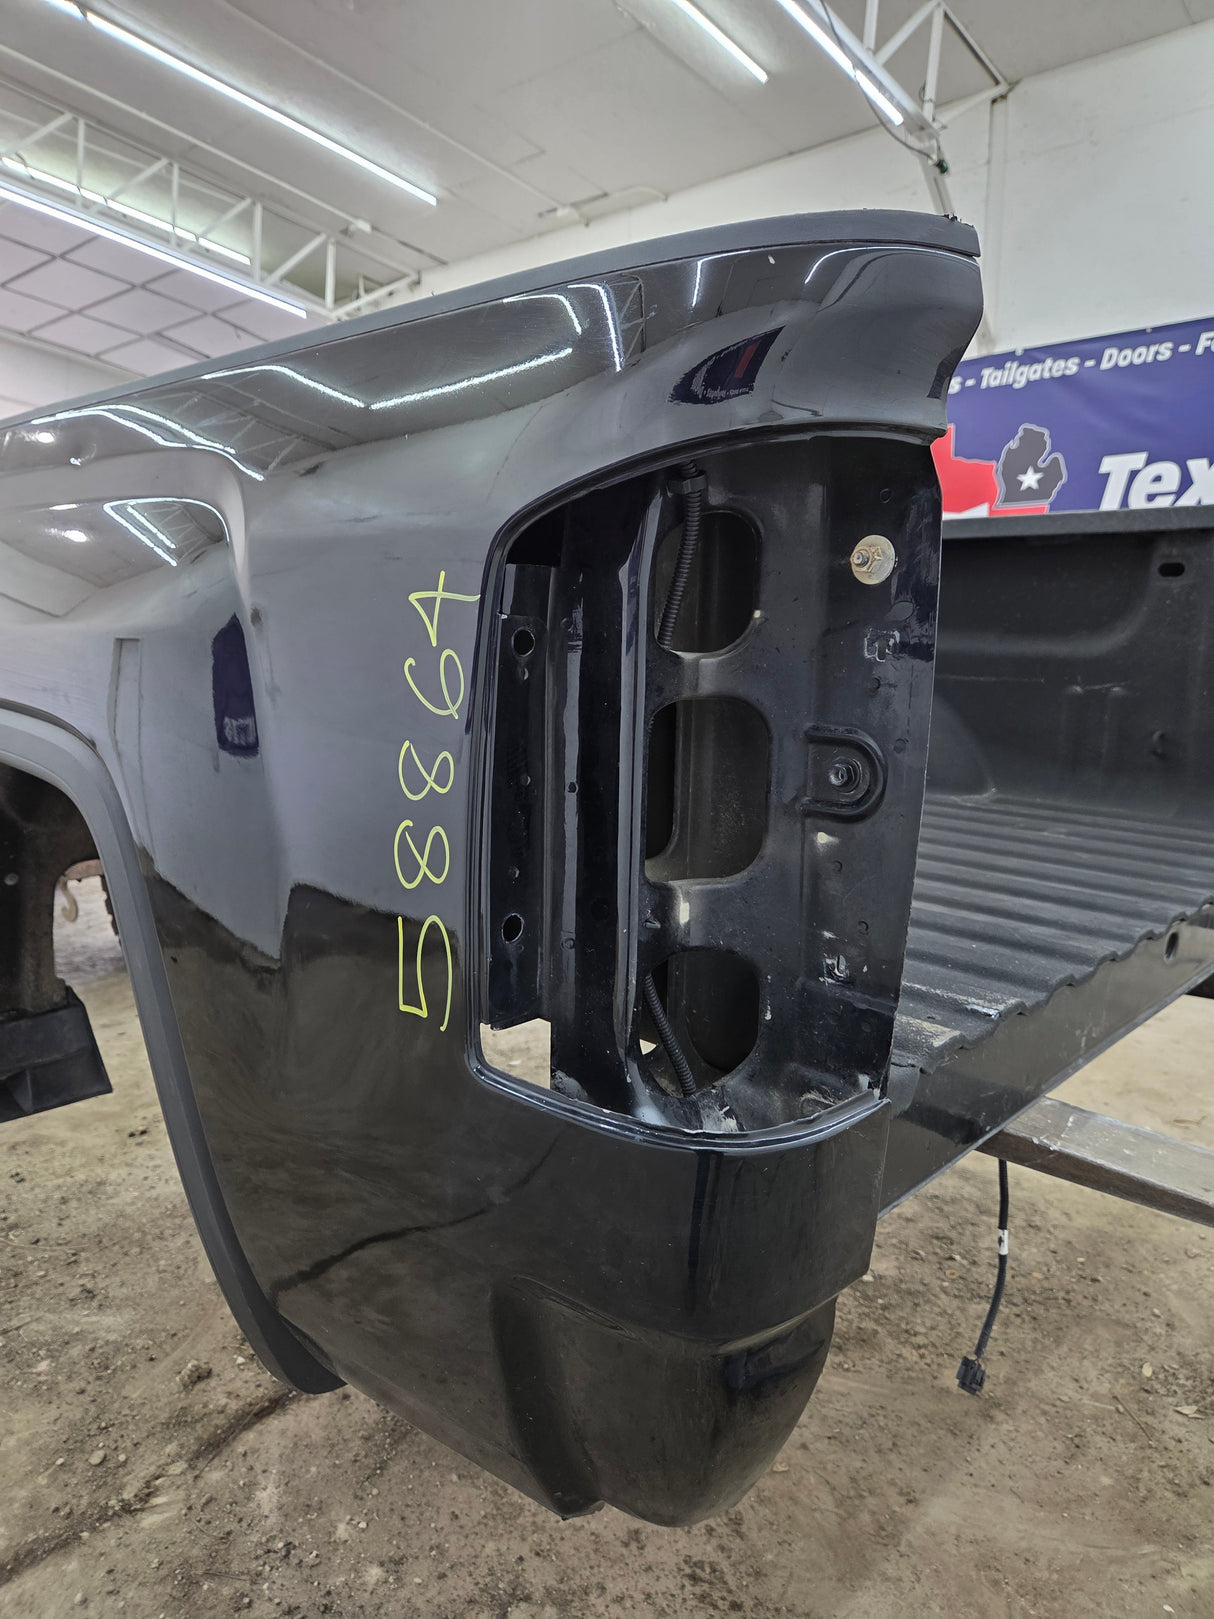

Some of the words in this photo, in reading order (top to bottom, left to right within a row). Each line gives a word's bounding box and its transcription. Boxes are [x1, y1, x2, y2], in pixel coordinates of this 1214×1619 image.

[980, 356, 1081, 389] Tailgates
[1100, 341, 1174, 371] Doors
[394, 571, 481, 1031] 58864
